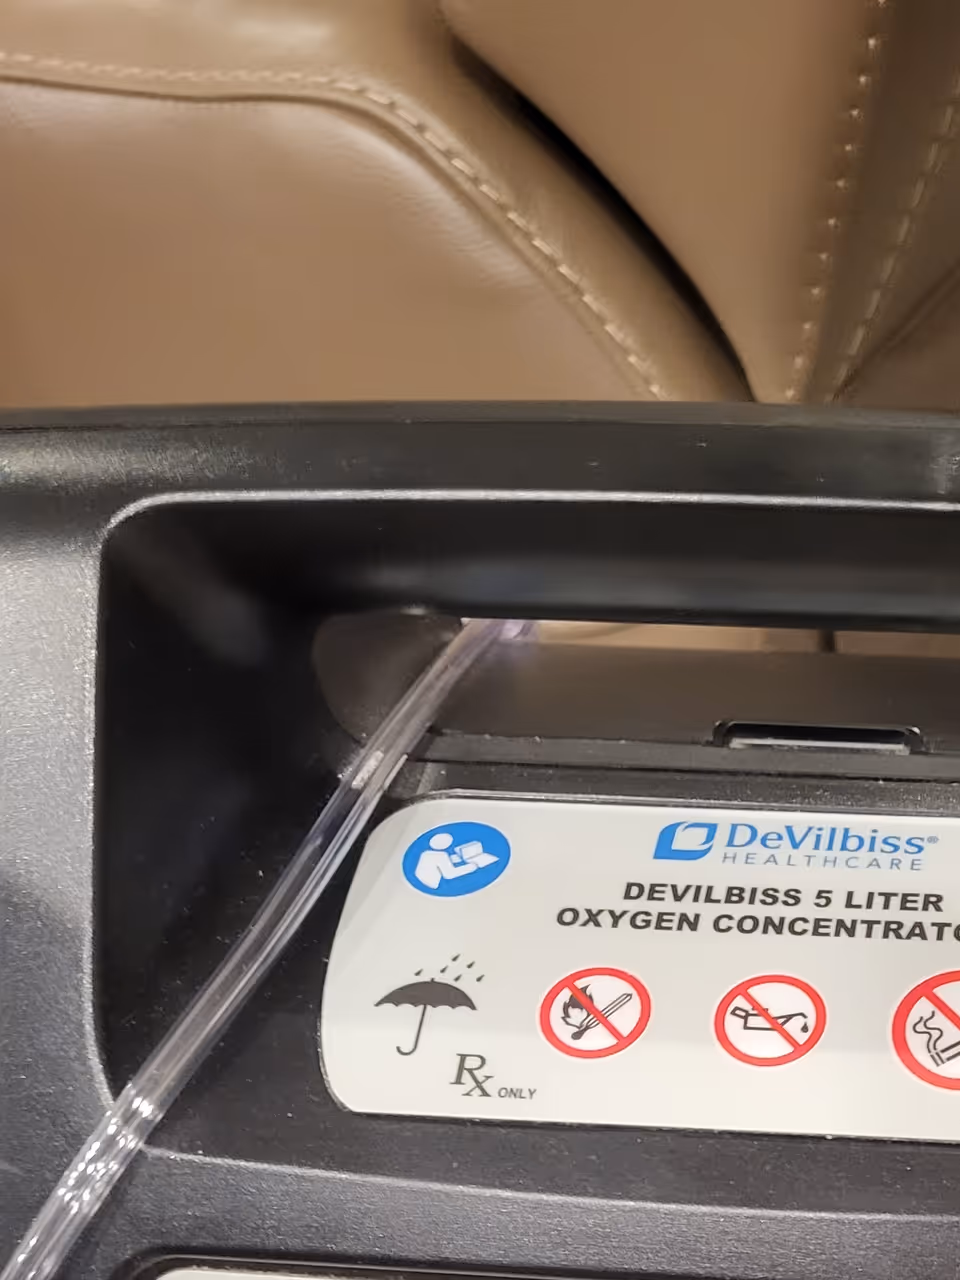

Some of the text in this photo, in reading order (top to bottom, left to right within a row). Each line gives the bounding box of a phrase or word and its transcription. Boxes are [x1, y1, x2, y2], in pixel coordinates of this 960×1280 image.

[722, 851, 923, 871] HEALTHCARE
[623, 882, 944, 912] DEVILBISS 5 LITER
[556, 907, 701, 932] OXYGEN
[498, 1086, 537, 1100] ONLY
